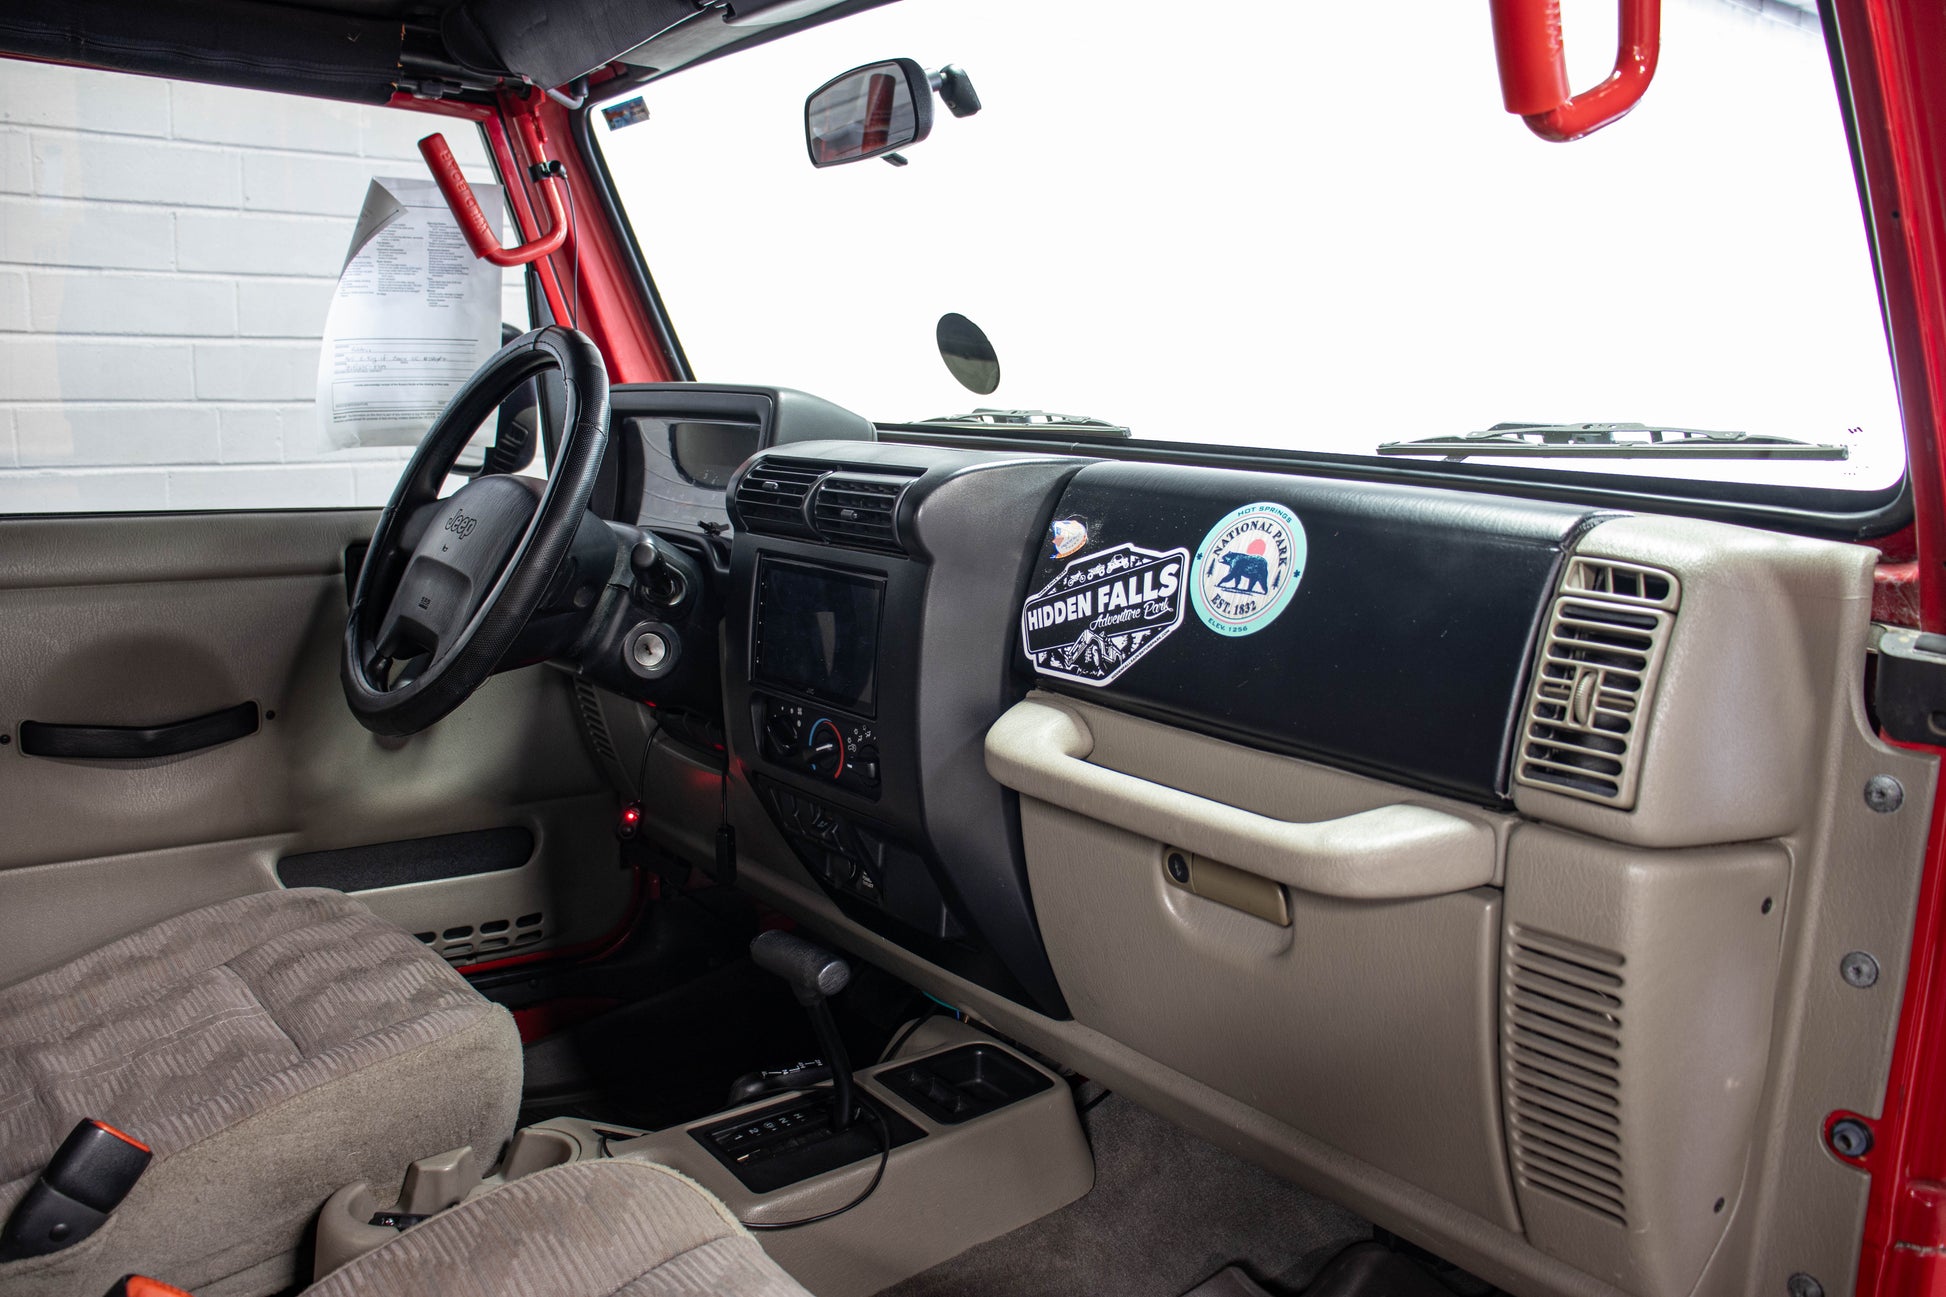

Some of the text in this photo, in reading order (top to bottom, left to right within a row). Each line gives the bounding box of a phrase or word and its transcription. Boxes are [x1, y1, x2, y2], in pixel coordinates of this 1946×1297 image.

[440, 149, 469, 191] BOAR
[444, 508, 477, 540] Jeep
[1237, 505, 1293, 524] HOT SPRINGS
[1213, 522, 1288, 568] NATIONAL PARK
[1027, 590, 1092, 632] HIDDEN
[1097, 563, 1179, 611] FALLS
[1210, 593, 1257, 617] EST. 1832
[1089, 599, 1174, 631] Adventure Park
[1228, 624, 1249, 633] 1256
